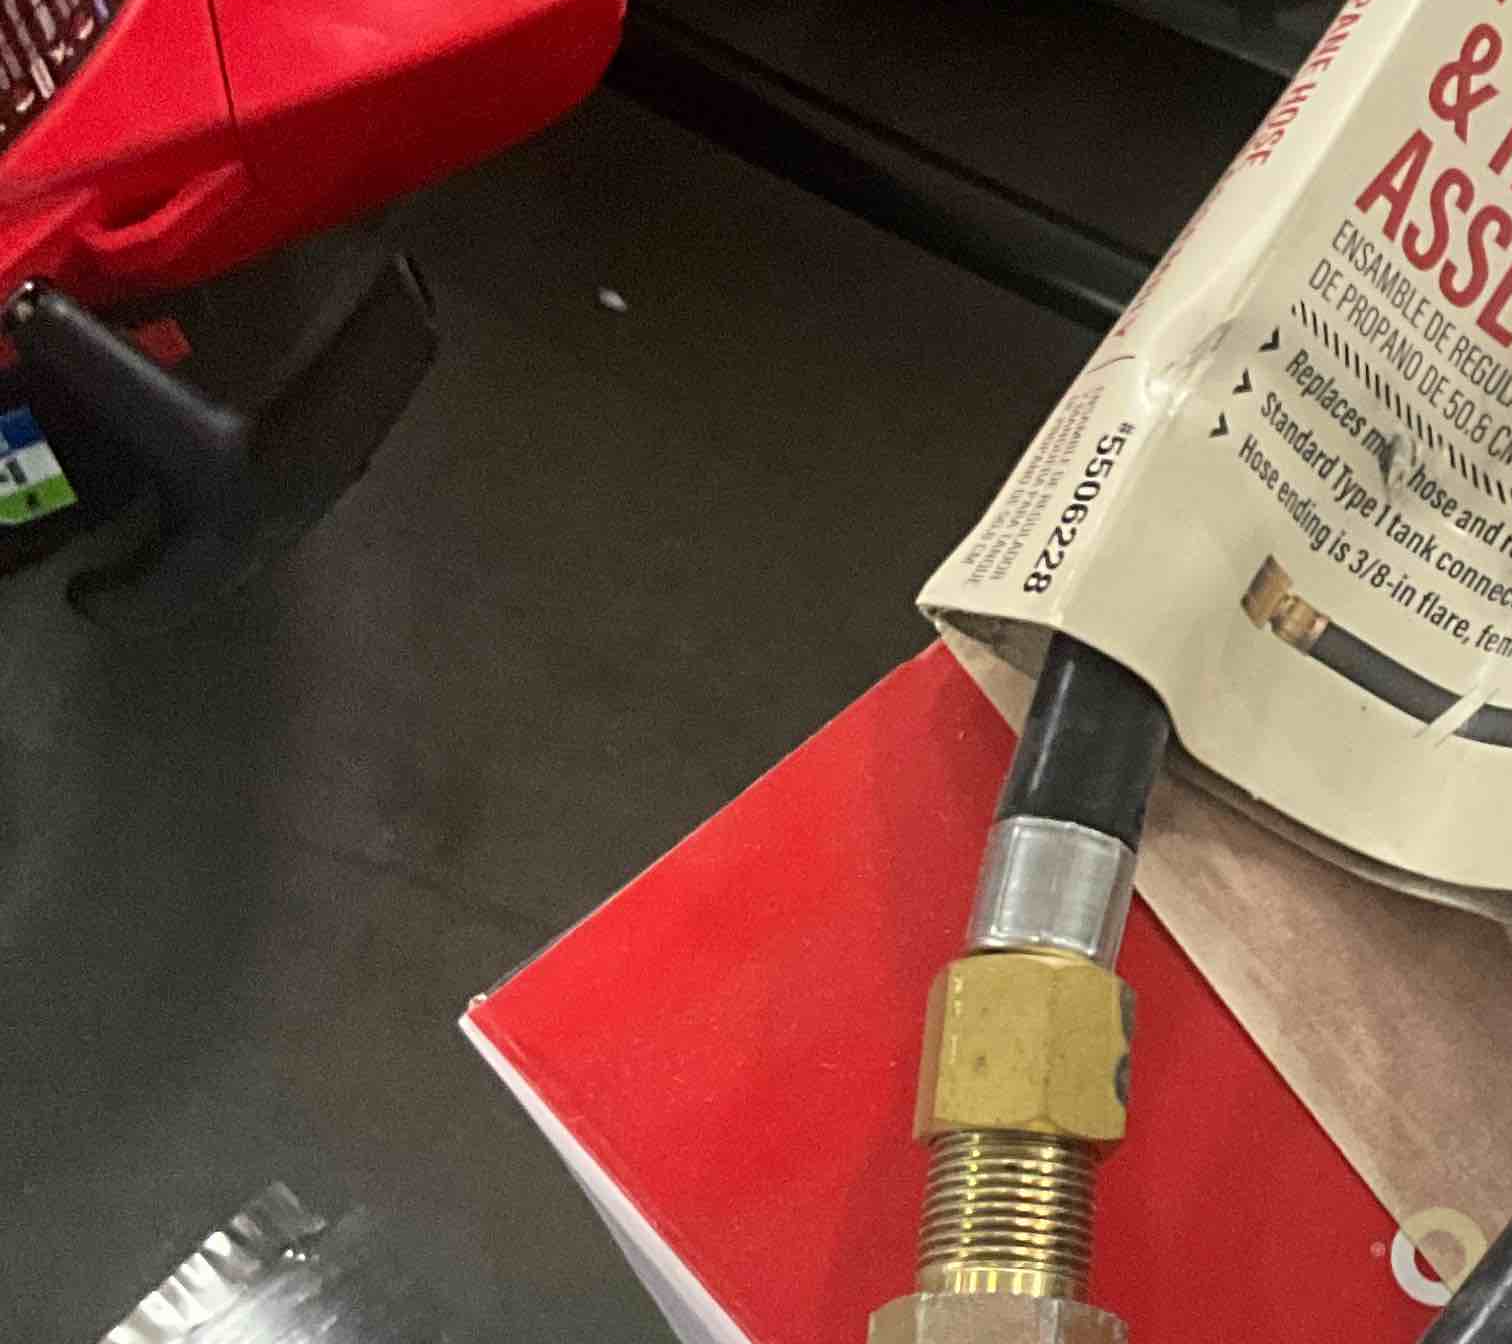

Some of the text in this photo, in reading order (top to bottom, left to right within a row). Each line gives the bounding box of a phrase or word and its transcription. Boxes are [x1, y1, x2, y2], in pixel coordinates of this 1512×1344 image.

[1427, 22, 1502, 142] &
[1307, 257, 1344, 303] DE
[1337, 283, 1424, 380] PROPANO
[1416, 364, 1449, 403] DE
[1333, 219, 1432, 329] ENSAMBLE
[1422, 309, 1456, 354] DE
[1022, 422, 1133, 594] #5506228
[1260, 391, 1340, 480] Standard
[1331, 463, 1378, 518] Type
[1374, 503, 1391, 527] 1
[1385, 512, 1438, 563] tank
[1285, 348, 1370, 439] Replaces
[1405, 462, 1458, 518] hose
[1454, 509, 1505, 546] and
[1237, 433, 1280, 491] Hose
[1276, 481, 1349, 547] ending
[1325, 523, 1357, 563] is
[1347, 548, 1417, 607] 3/8-in
[1411, 585, 1478, 647] flare,
